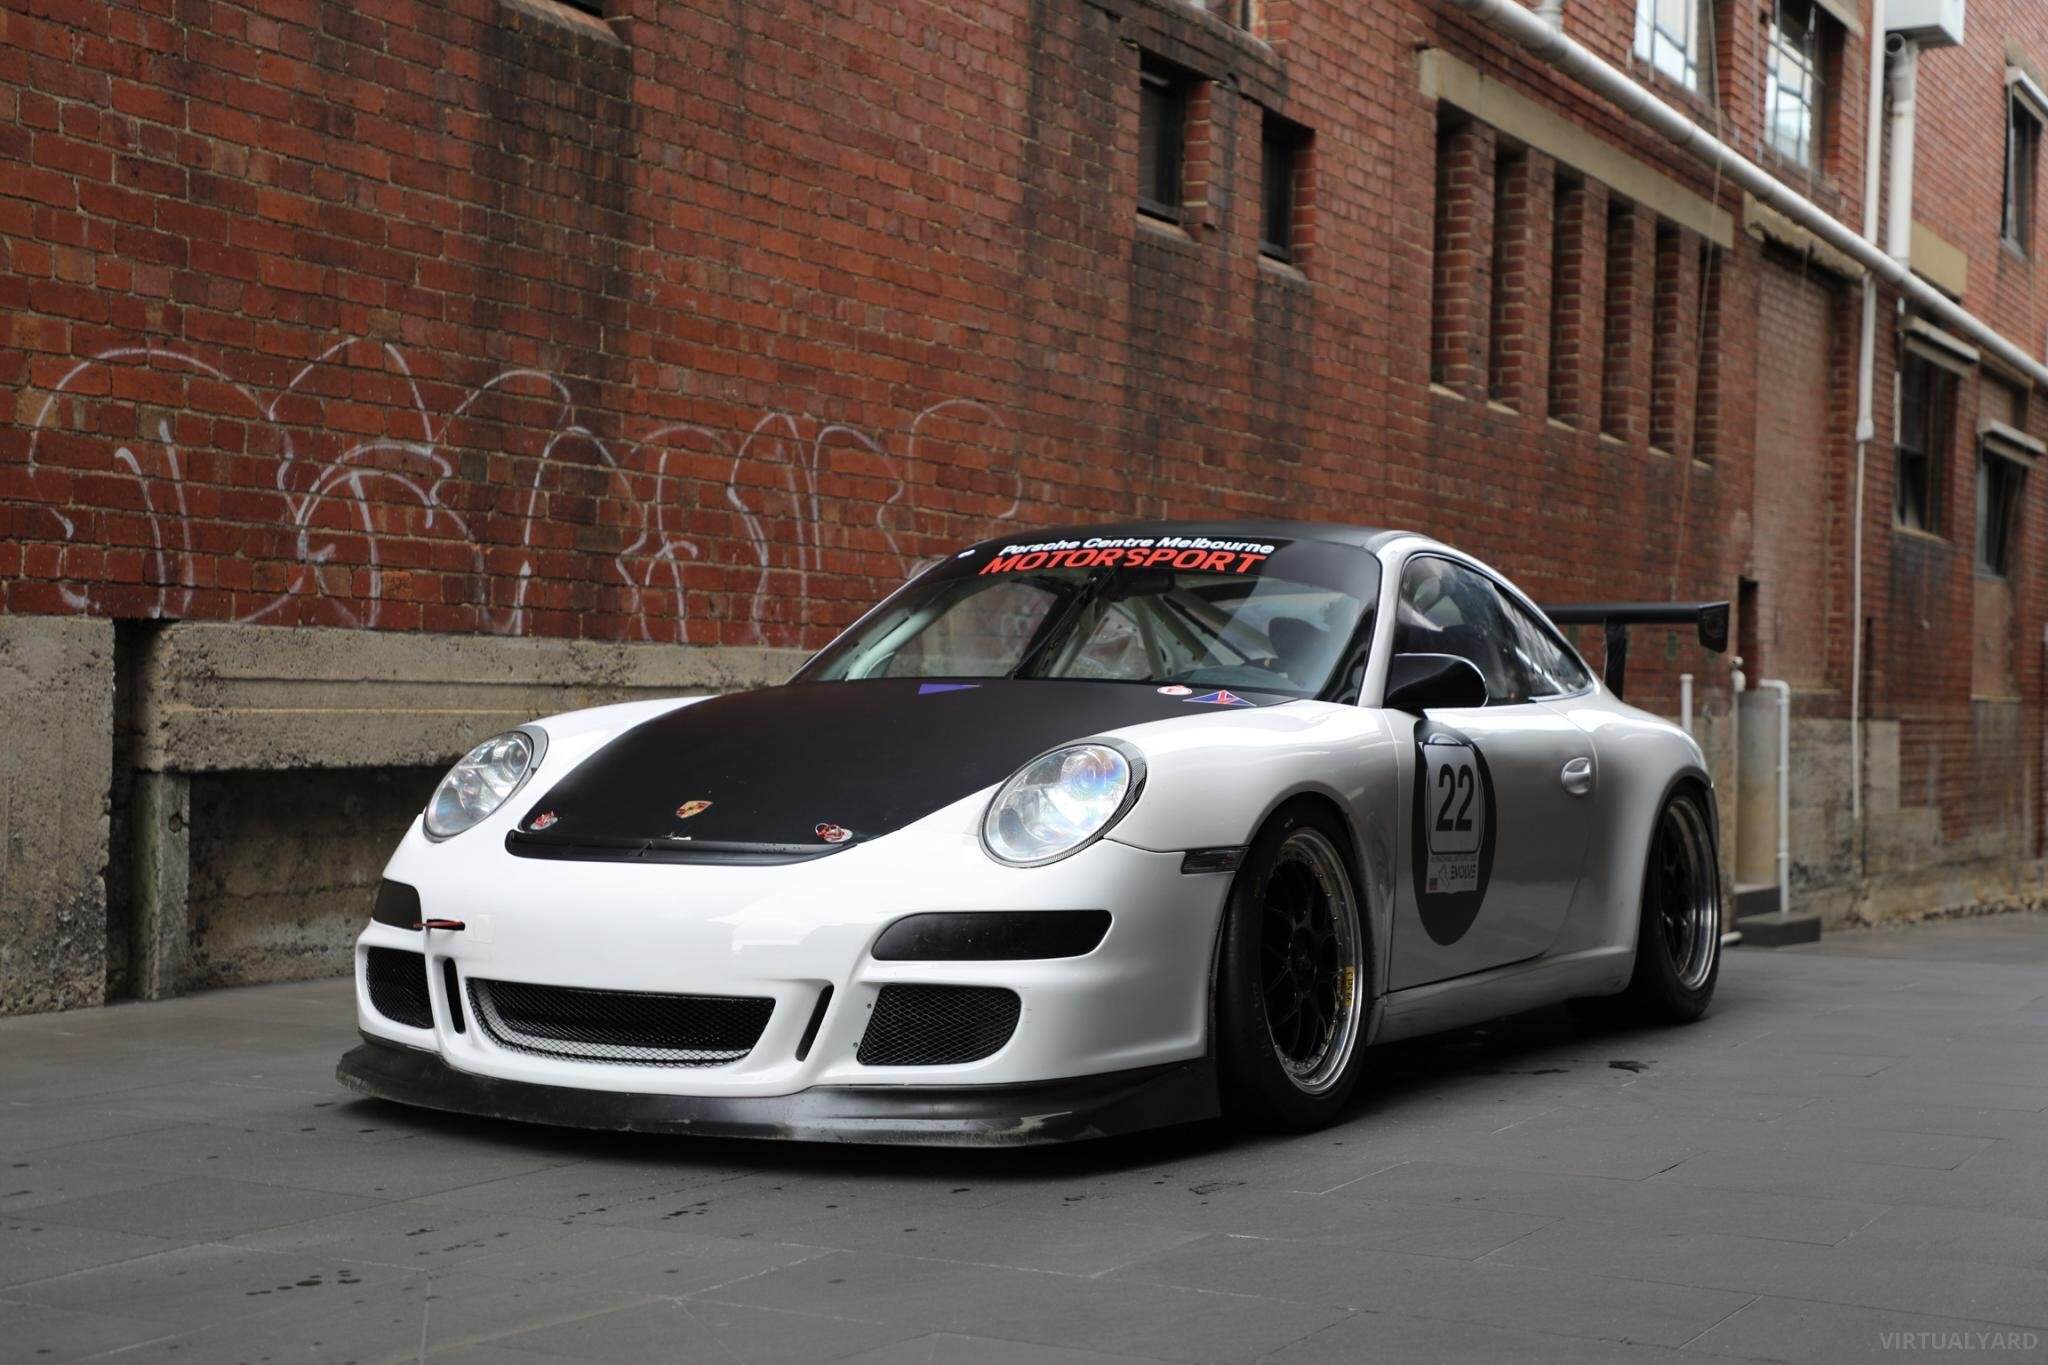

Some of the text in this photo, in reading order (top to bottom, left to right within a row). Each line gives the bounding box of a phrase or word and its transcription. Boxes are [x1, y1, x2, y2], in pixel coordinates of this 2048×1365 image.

[998, 536, 1275, 557] Porsche Centre Melbourne
[978, 548, 1268, 576] MOTORSPORT
[1435, 763, 1475, 832] 22
